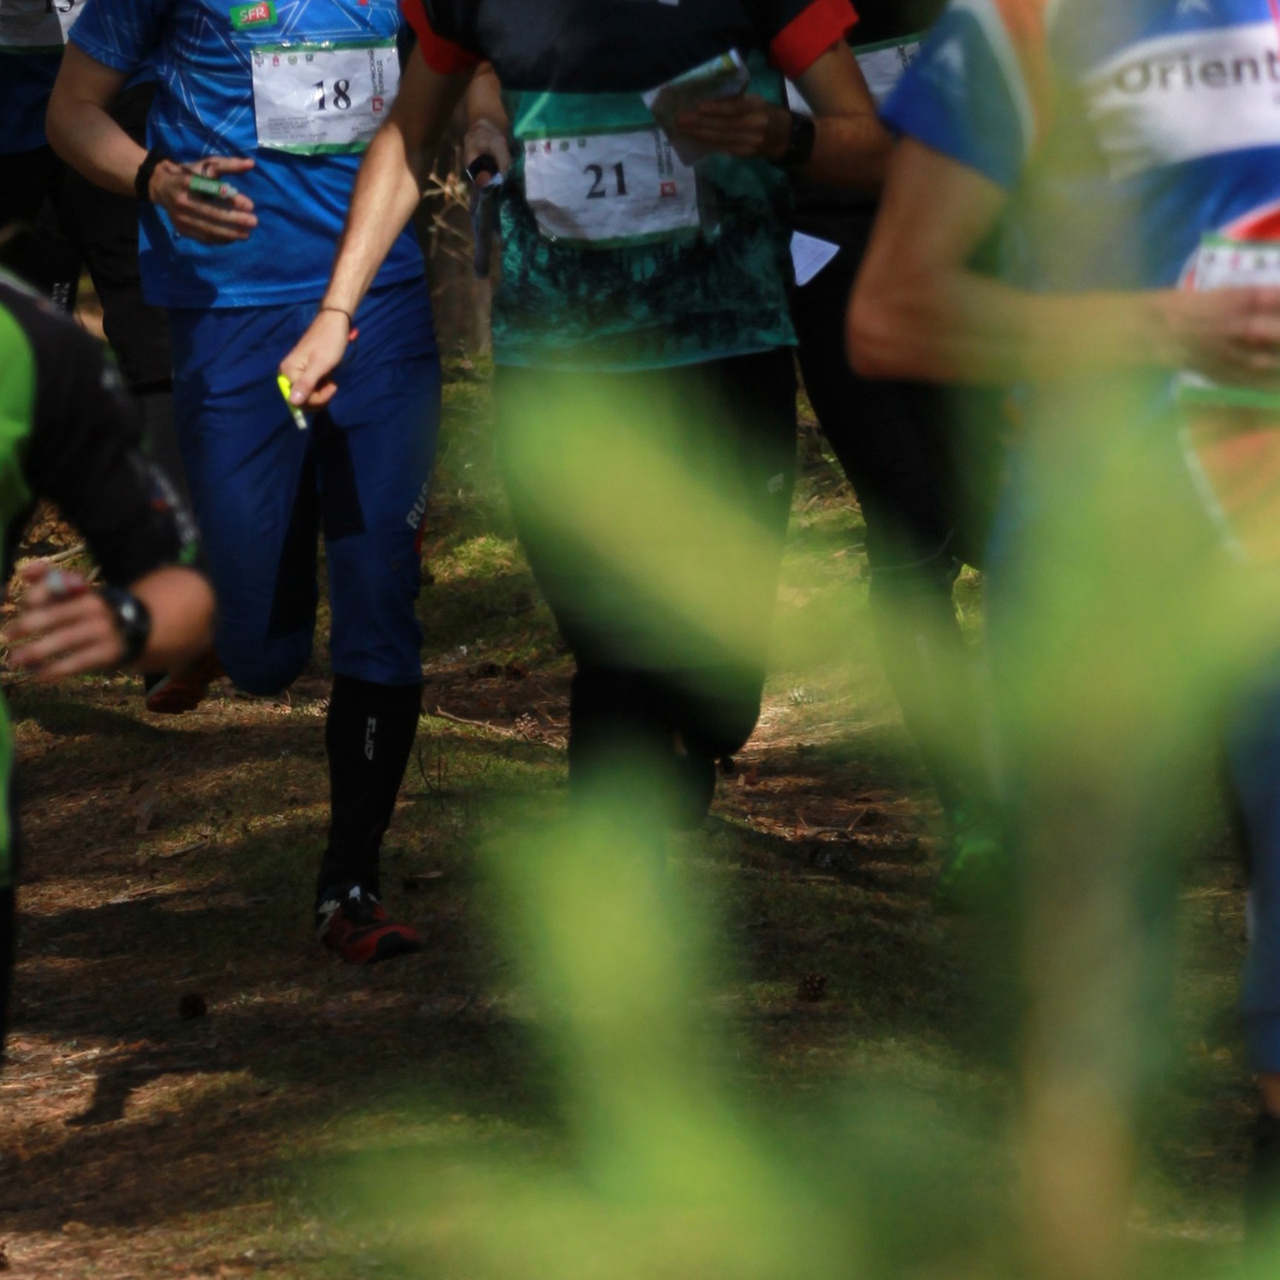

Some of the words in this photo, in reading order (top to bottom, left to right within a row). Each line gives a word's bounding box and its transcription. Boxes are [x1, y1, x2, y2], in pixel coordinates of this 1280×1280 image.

[239, 4, 267, 23] SFR
[312, 79, 352, 111] 18
[583, 160, 629, 200] 21
